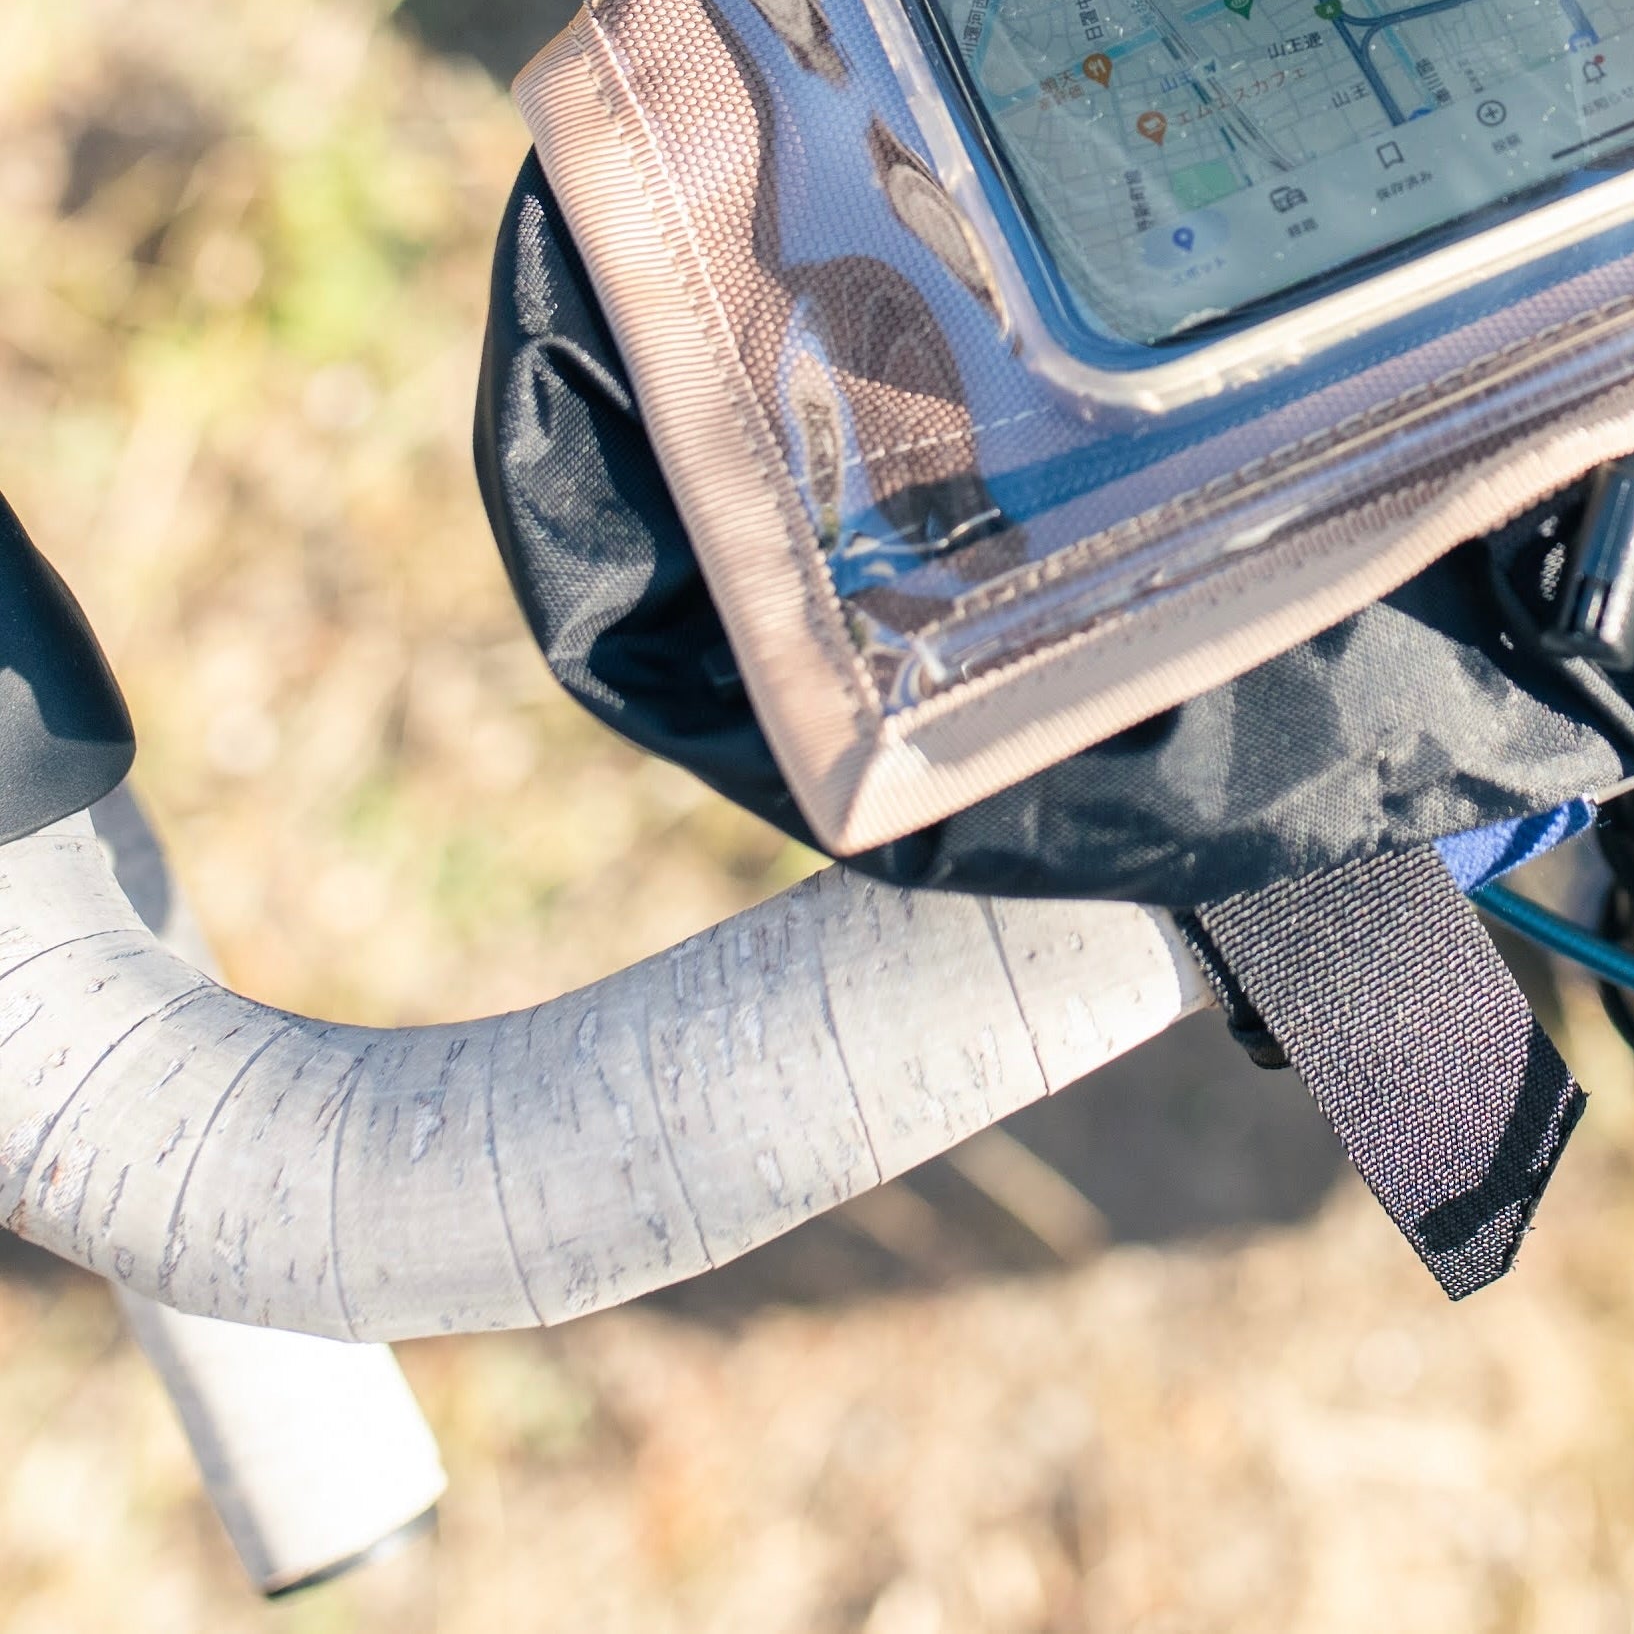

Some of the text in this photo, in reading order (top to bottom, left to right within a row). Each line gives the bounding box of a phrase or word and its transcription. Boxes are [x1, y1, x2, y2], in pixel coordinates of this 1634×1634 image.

[1265, 30, 1324, 59] 山王通
[1329, 80, 1370, 109] 山王
